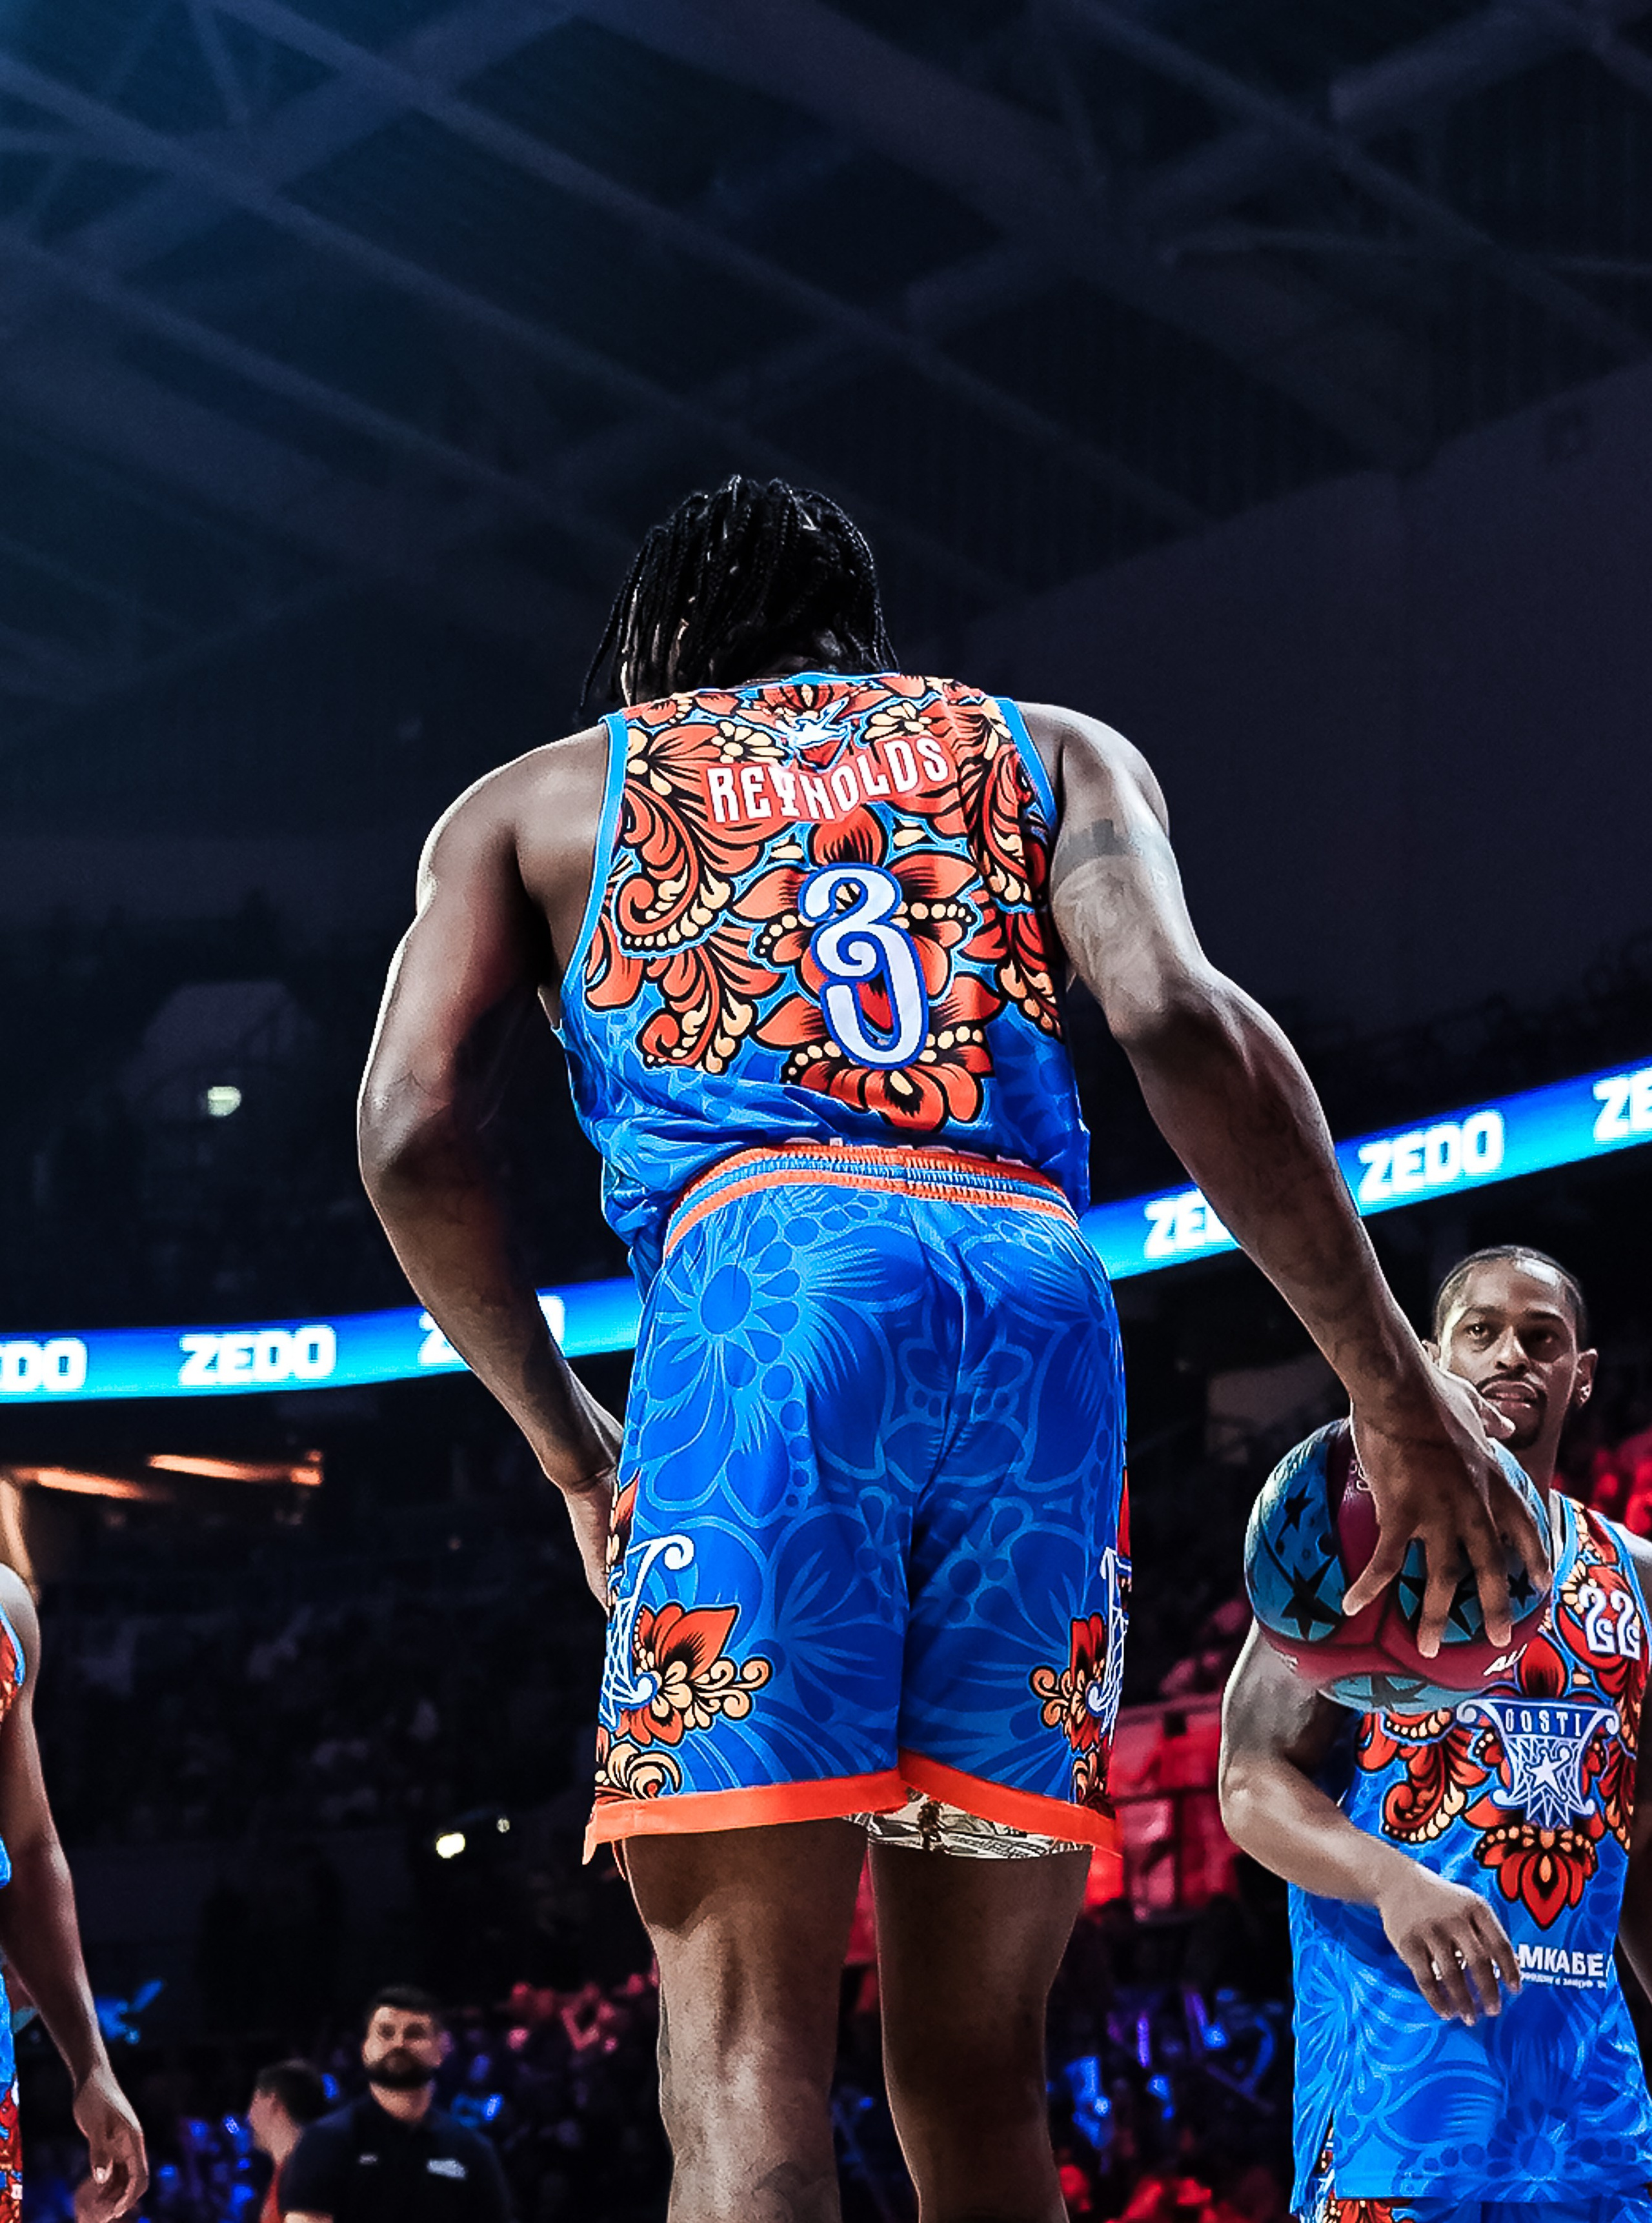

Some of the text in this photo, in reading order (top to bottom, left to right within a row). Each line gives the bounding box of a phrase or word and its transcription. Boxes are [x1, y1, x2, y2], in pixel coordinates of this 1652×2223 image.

[707, 737, 949, 823] REYNOLDS
[801, 864, 927, 1067] 3
[1359, 1110, 1504, 1203] ZEDO
[0, 1338, 88, 1393] DO
[179, 1325, 336, 1386] ZEDO
[1578, 1584, 1640, 1661] 22
[1515, 1944, 1604, 1977] МКАБЕ
